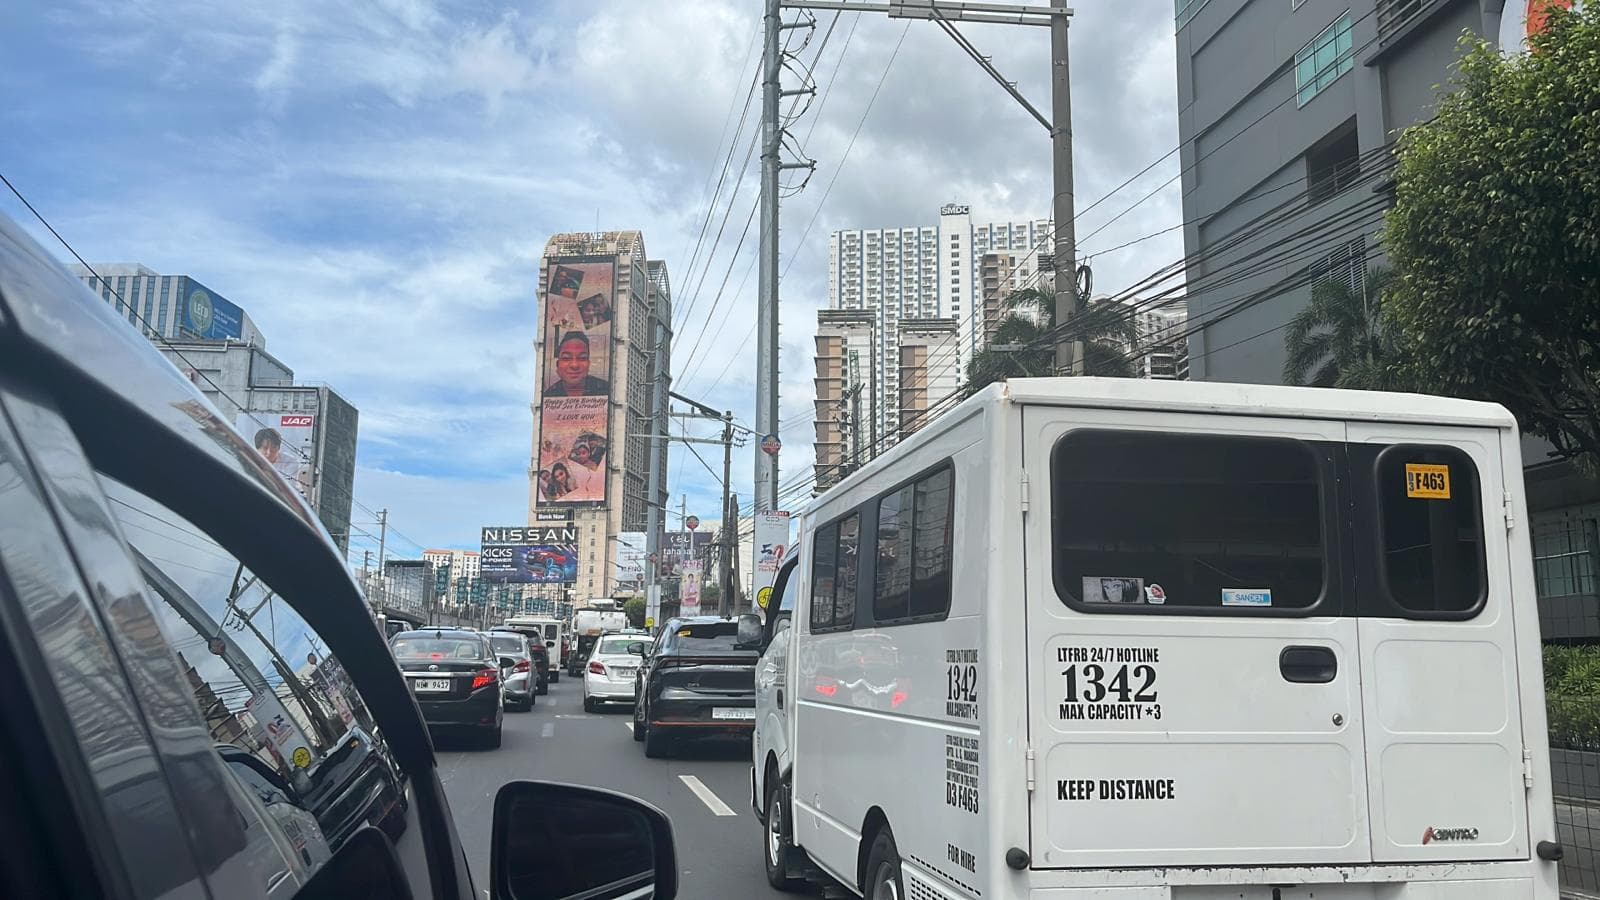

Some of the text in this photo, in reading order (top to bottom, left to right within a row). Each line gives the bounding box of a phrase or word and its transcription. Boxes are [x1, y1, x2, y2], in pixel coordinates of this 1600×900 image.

[941, 206, 968, 214] SMDC
[1415, 472, 1445, 490] F463
[485, 529, 575, 541] NISSAN
[482, 548, 513, 557] KICKS
[1057, 647, 1159, 662] LTFRB 24/7 HOTLINE
[947, 665, 977, 702] 1342
[1061, 664, 1158, 702] 1342
[1059, 704, 1085, 720] MAX
[1087, 704, 1142, 720] CAPACITY
[946, 782, 978, 814] D3 F463
[1057, 779, 1175, 800] KEEP DISTANCE
[947, 843, 976, 874] FOR HIRE
